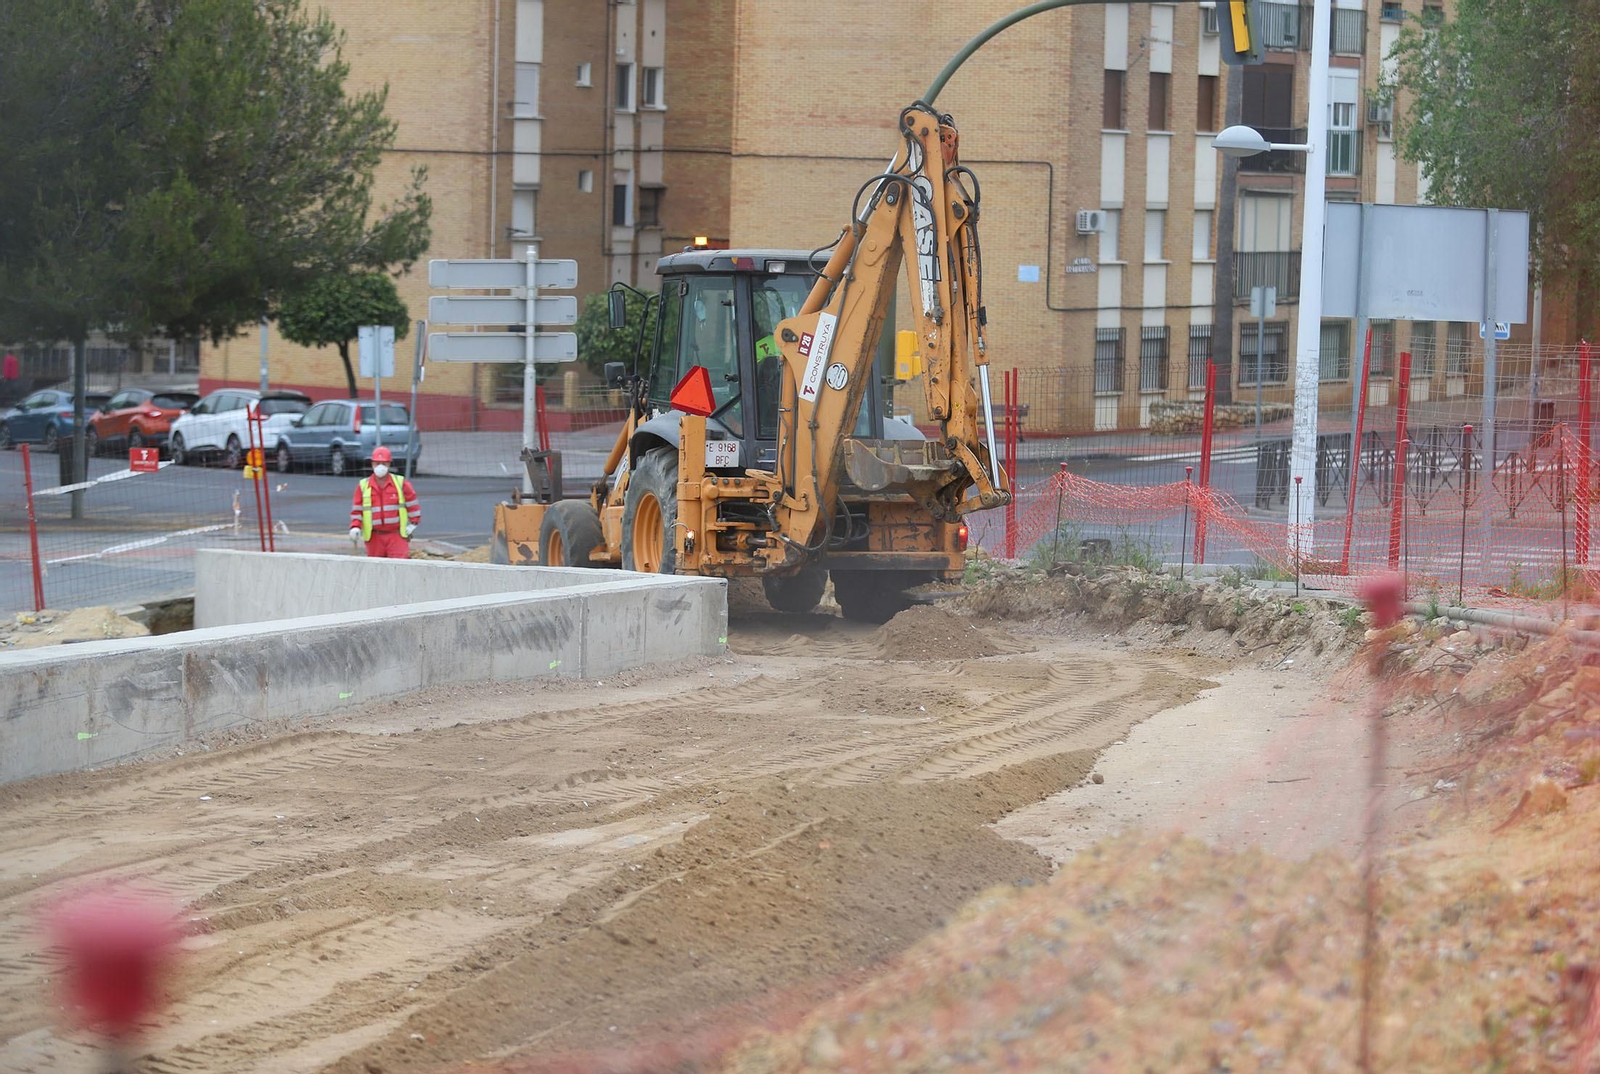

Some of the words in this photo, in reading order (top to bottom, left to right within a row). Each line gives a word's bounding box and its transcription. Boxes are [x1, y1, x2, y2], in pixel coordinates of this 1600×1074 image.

[911, 175, 943, 282] CASE
[801, 335, 812, 347] 28
[799, 347, 809, 355] R
[809, 324, 831, 383] CONSTRUYA
[708, 443, 714, 453] E
[718, 443, 737, 453] 9168
[715, 455, 730, 465] BFC
